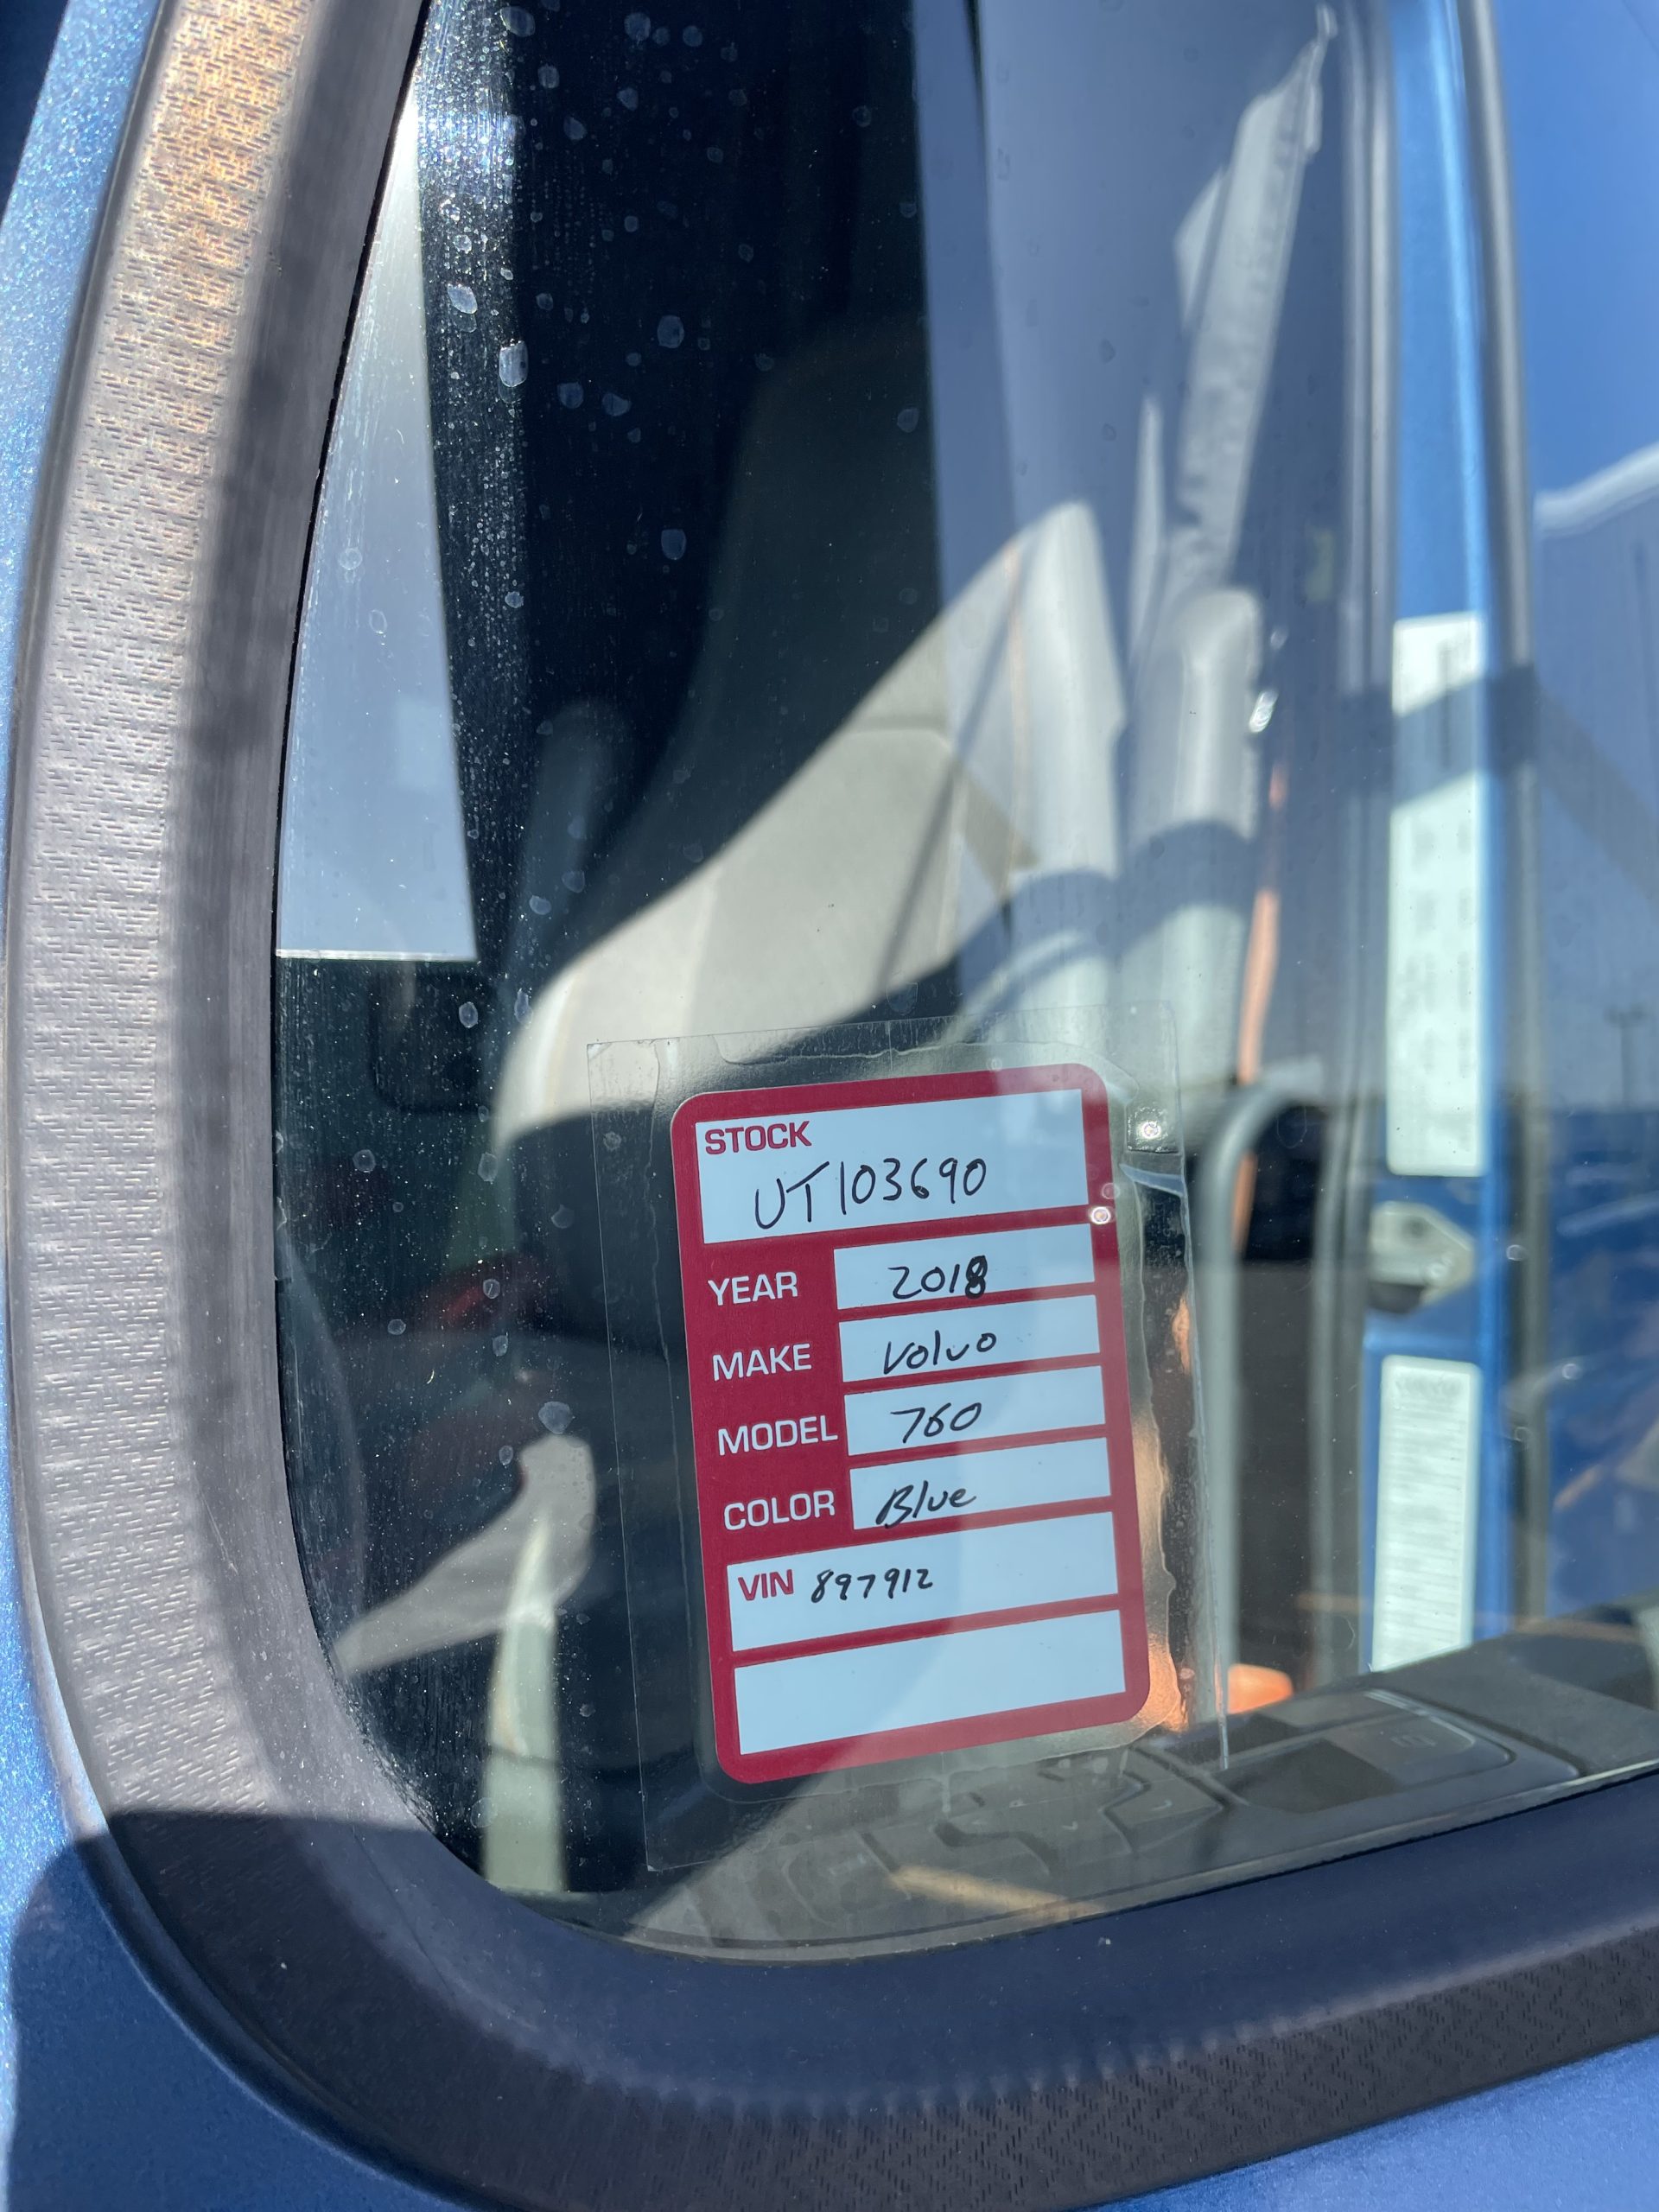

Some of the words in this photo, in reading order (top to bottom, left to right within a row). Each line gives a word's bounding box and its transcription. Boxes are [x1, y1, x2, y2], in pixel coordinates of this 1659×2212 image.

[704, 1121, 812, 1154] STOCK
[754, 1157, 987, 1230] UT103690
[707, 1271, 798, 1306] YEAR
[887, 1255, 988, 1299] 2018
[712, 1343, 812, 1382] MAKE
[717, 1414, 838, 1456] MODEL
[890, 1402, 982, 1444] 760
[723, 1490, 836, 1530] COLOR
[875, 1480, 976, 1529] Blue
[738, 1569, 794, 1601] VIN
[810, 1567, 933, 1604] 897912
